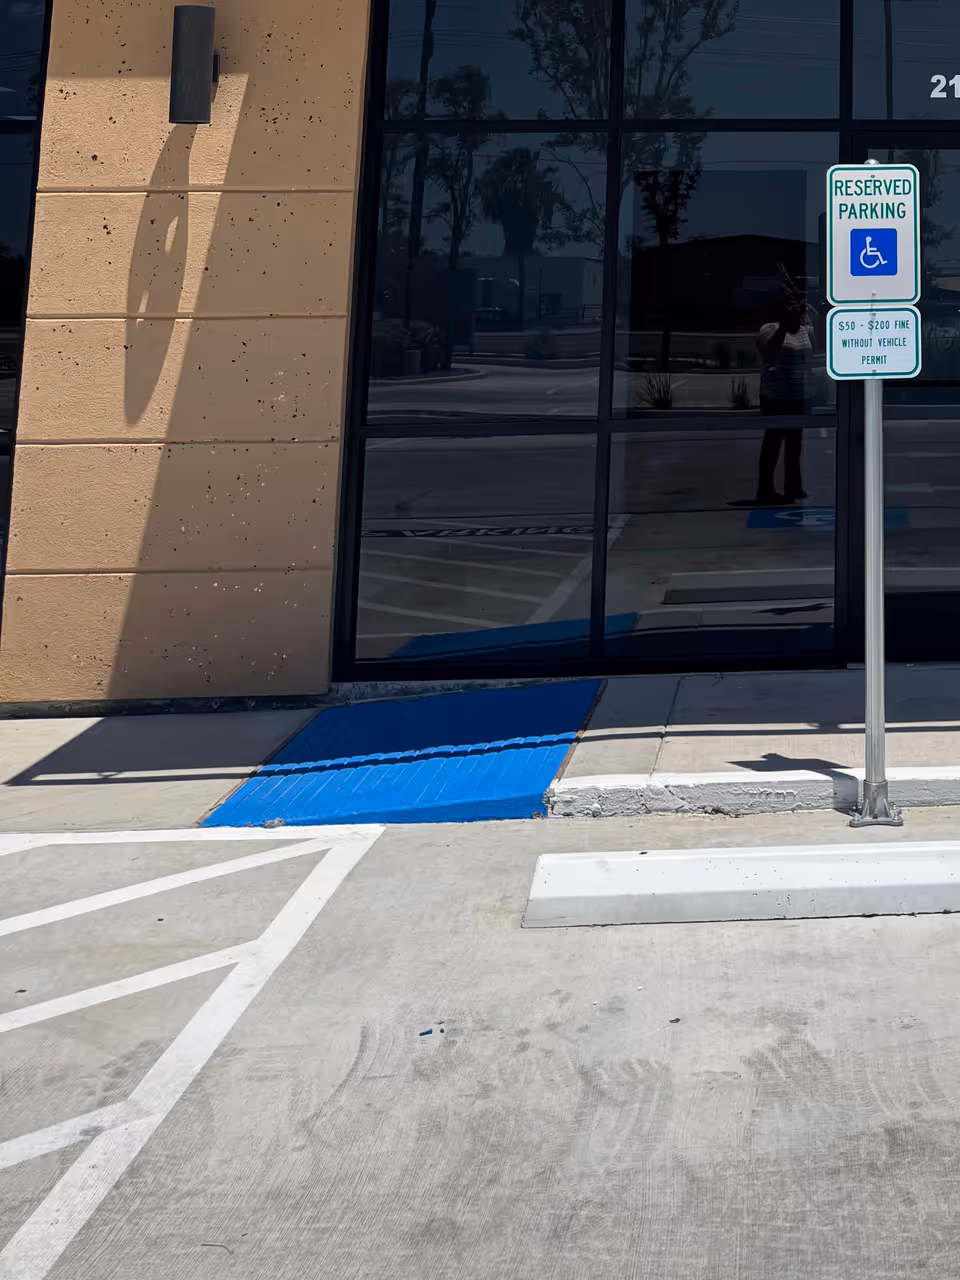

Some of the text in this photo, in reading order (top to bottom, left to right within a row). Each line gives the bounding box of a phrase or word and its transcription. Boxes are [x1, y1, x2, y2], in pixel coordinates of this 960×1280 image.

[834, 178, 912, 196] RESERVED
[838, 201, 906, 220] PARKING
[838, 321, 856, 332] $50
[867, 320, 890, 331] $200
[894, 319, 911, 330] FINE
[841, 337, 907, 349] WITHOUT VEHICLE
[861, 355, 887, 365] PERMIT
